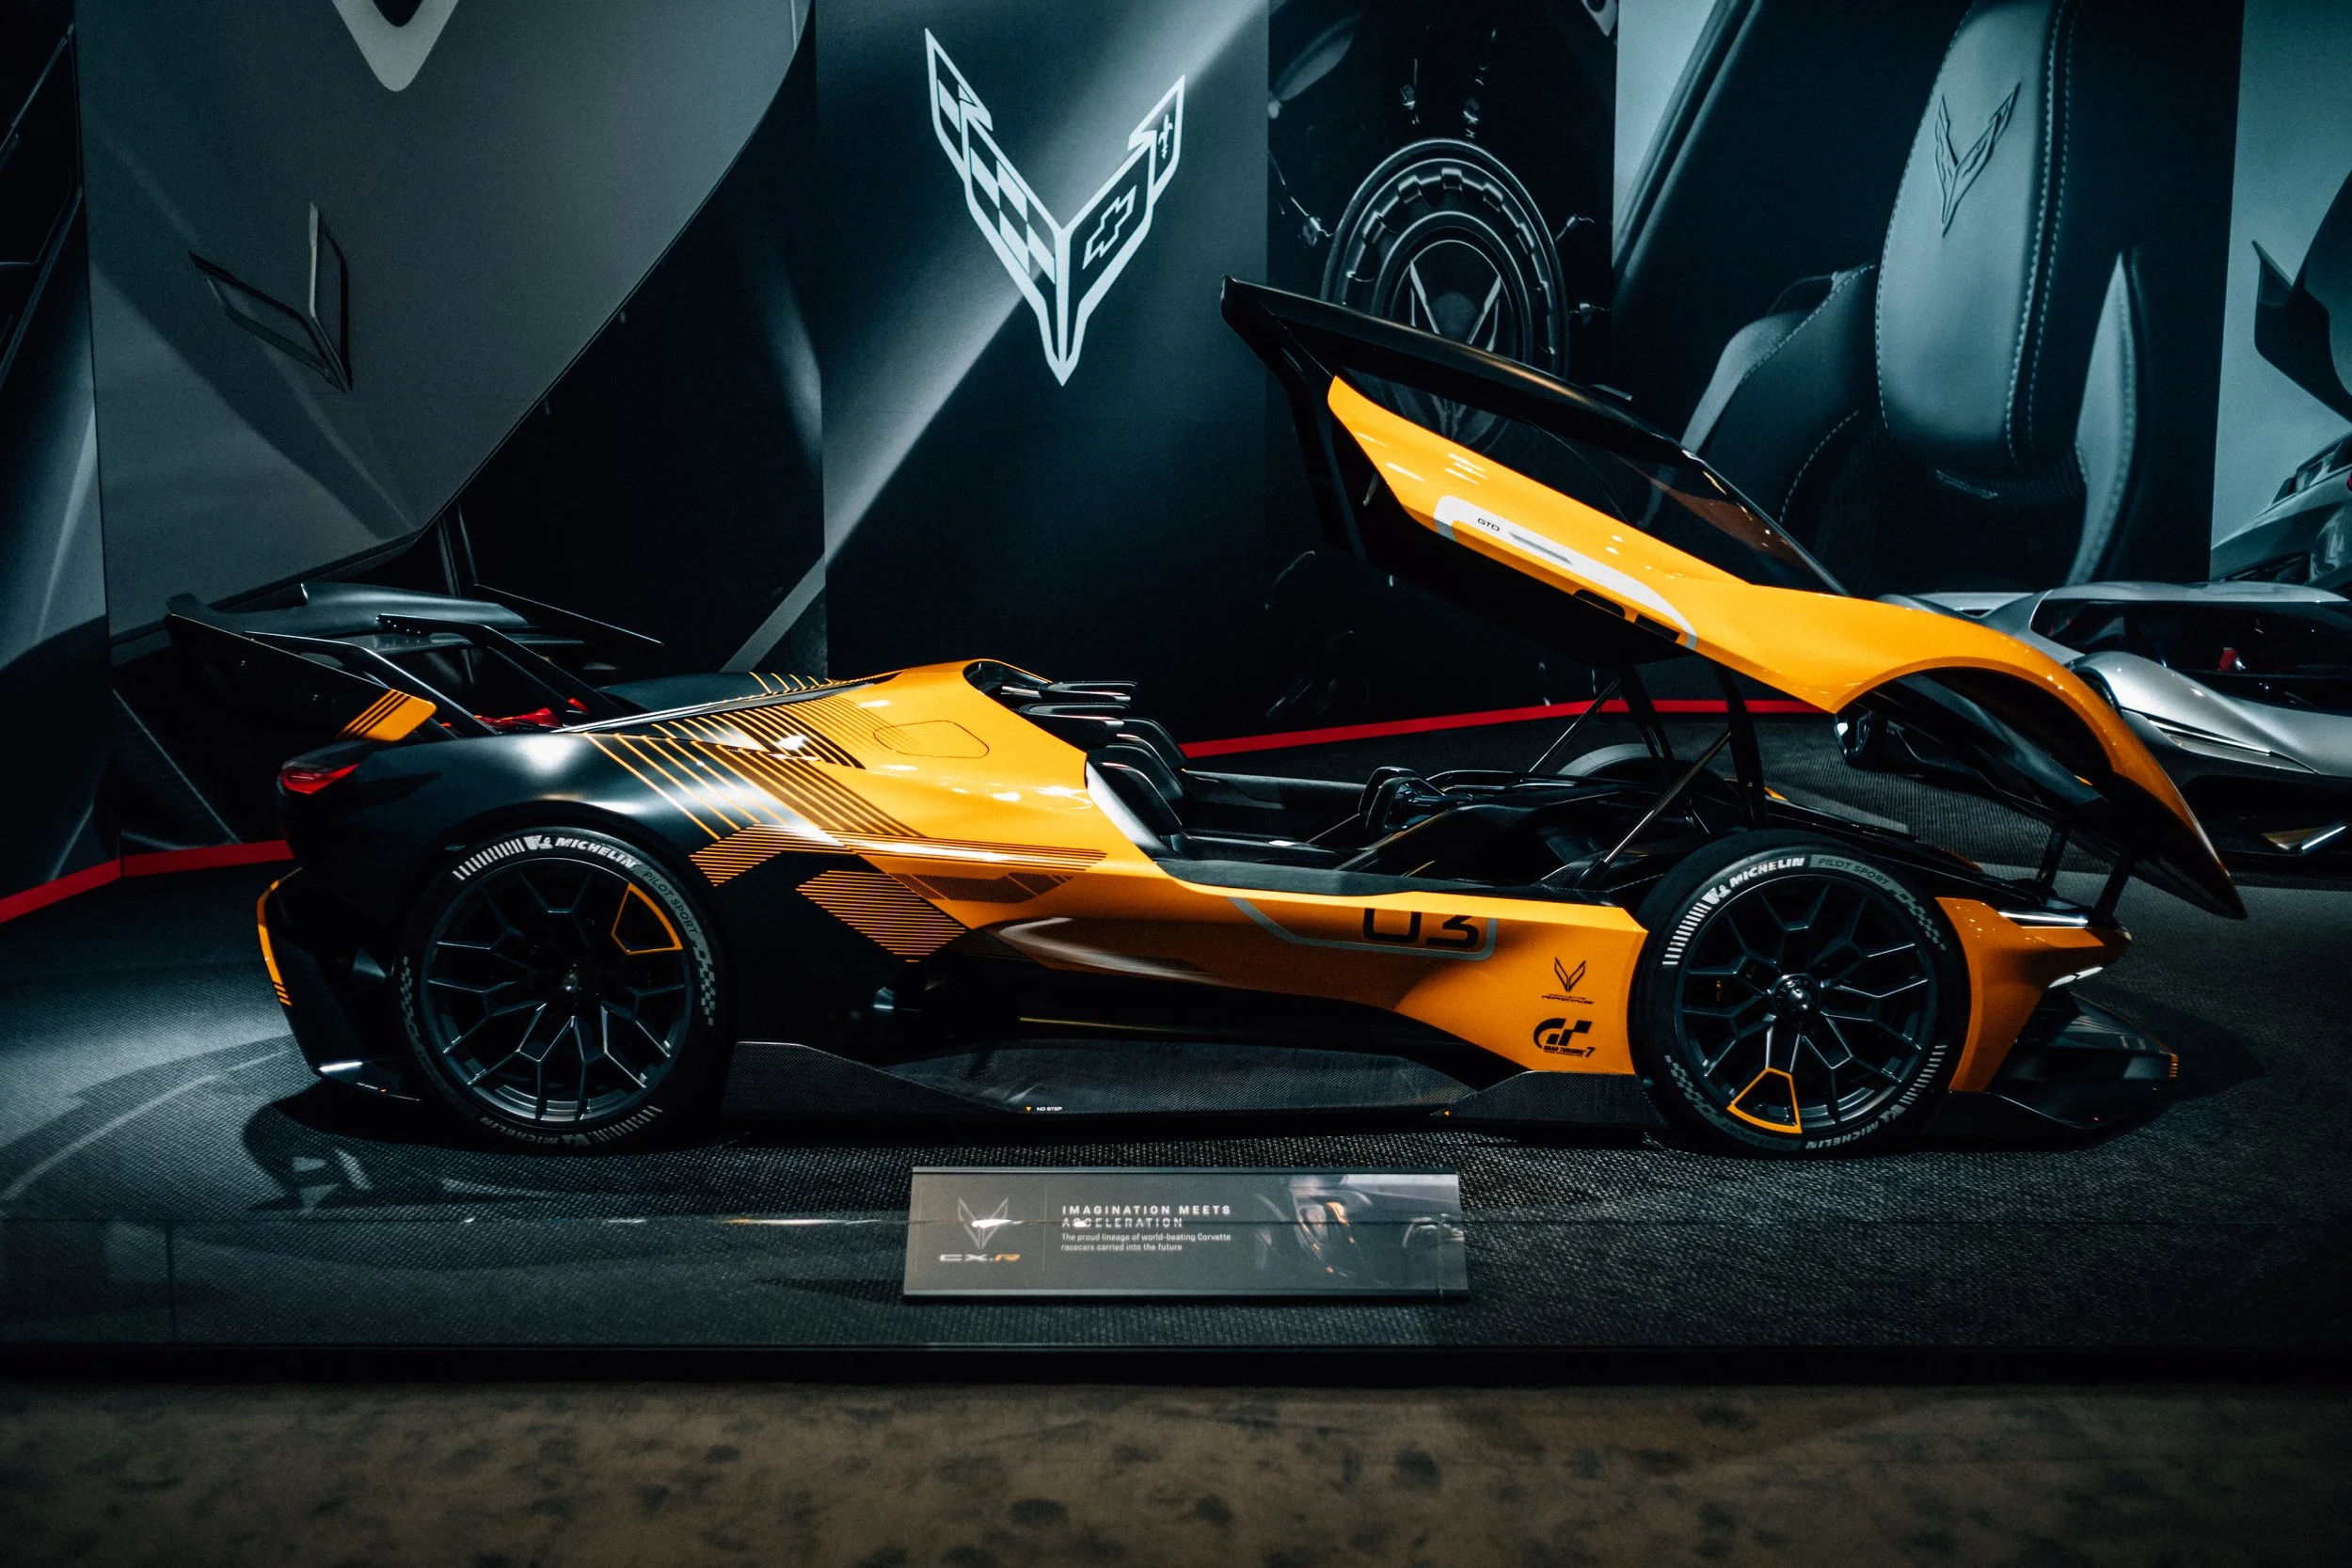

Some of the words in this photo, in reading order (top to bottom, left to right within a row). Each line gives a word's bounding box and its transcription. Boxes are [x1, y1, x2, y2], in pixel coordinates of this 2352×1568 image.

[554, 836, 637, 869] MICHELIN
[1728, 857, 1805, 888] MICHELIN
[1819, 858, 1851, 870] PILOT
[1852, 864, 1890, 885] SPORT
[643, 871, 675, 898] PILOT
[671, 898, 698, 935] SPORT
[1585, 1046, 1596, 1057] 7
[1804, 1119, 1880, 1150] MICHELIN
[1062, 1205, 1170, 1215] IMAGINATION
[1179, 1205, 1231, 1215] MEETS
[1077, 1233, 1100, 1243] proud
[1102, 1233, 1130, 1243] lineage
[1132, 1233, 1139, 1242] of
[1141, 1233, 1196, 1243] world-beating
[1197, 1233, 1231, 1242] Corvette
